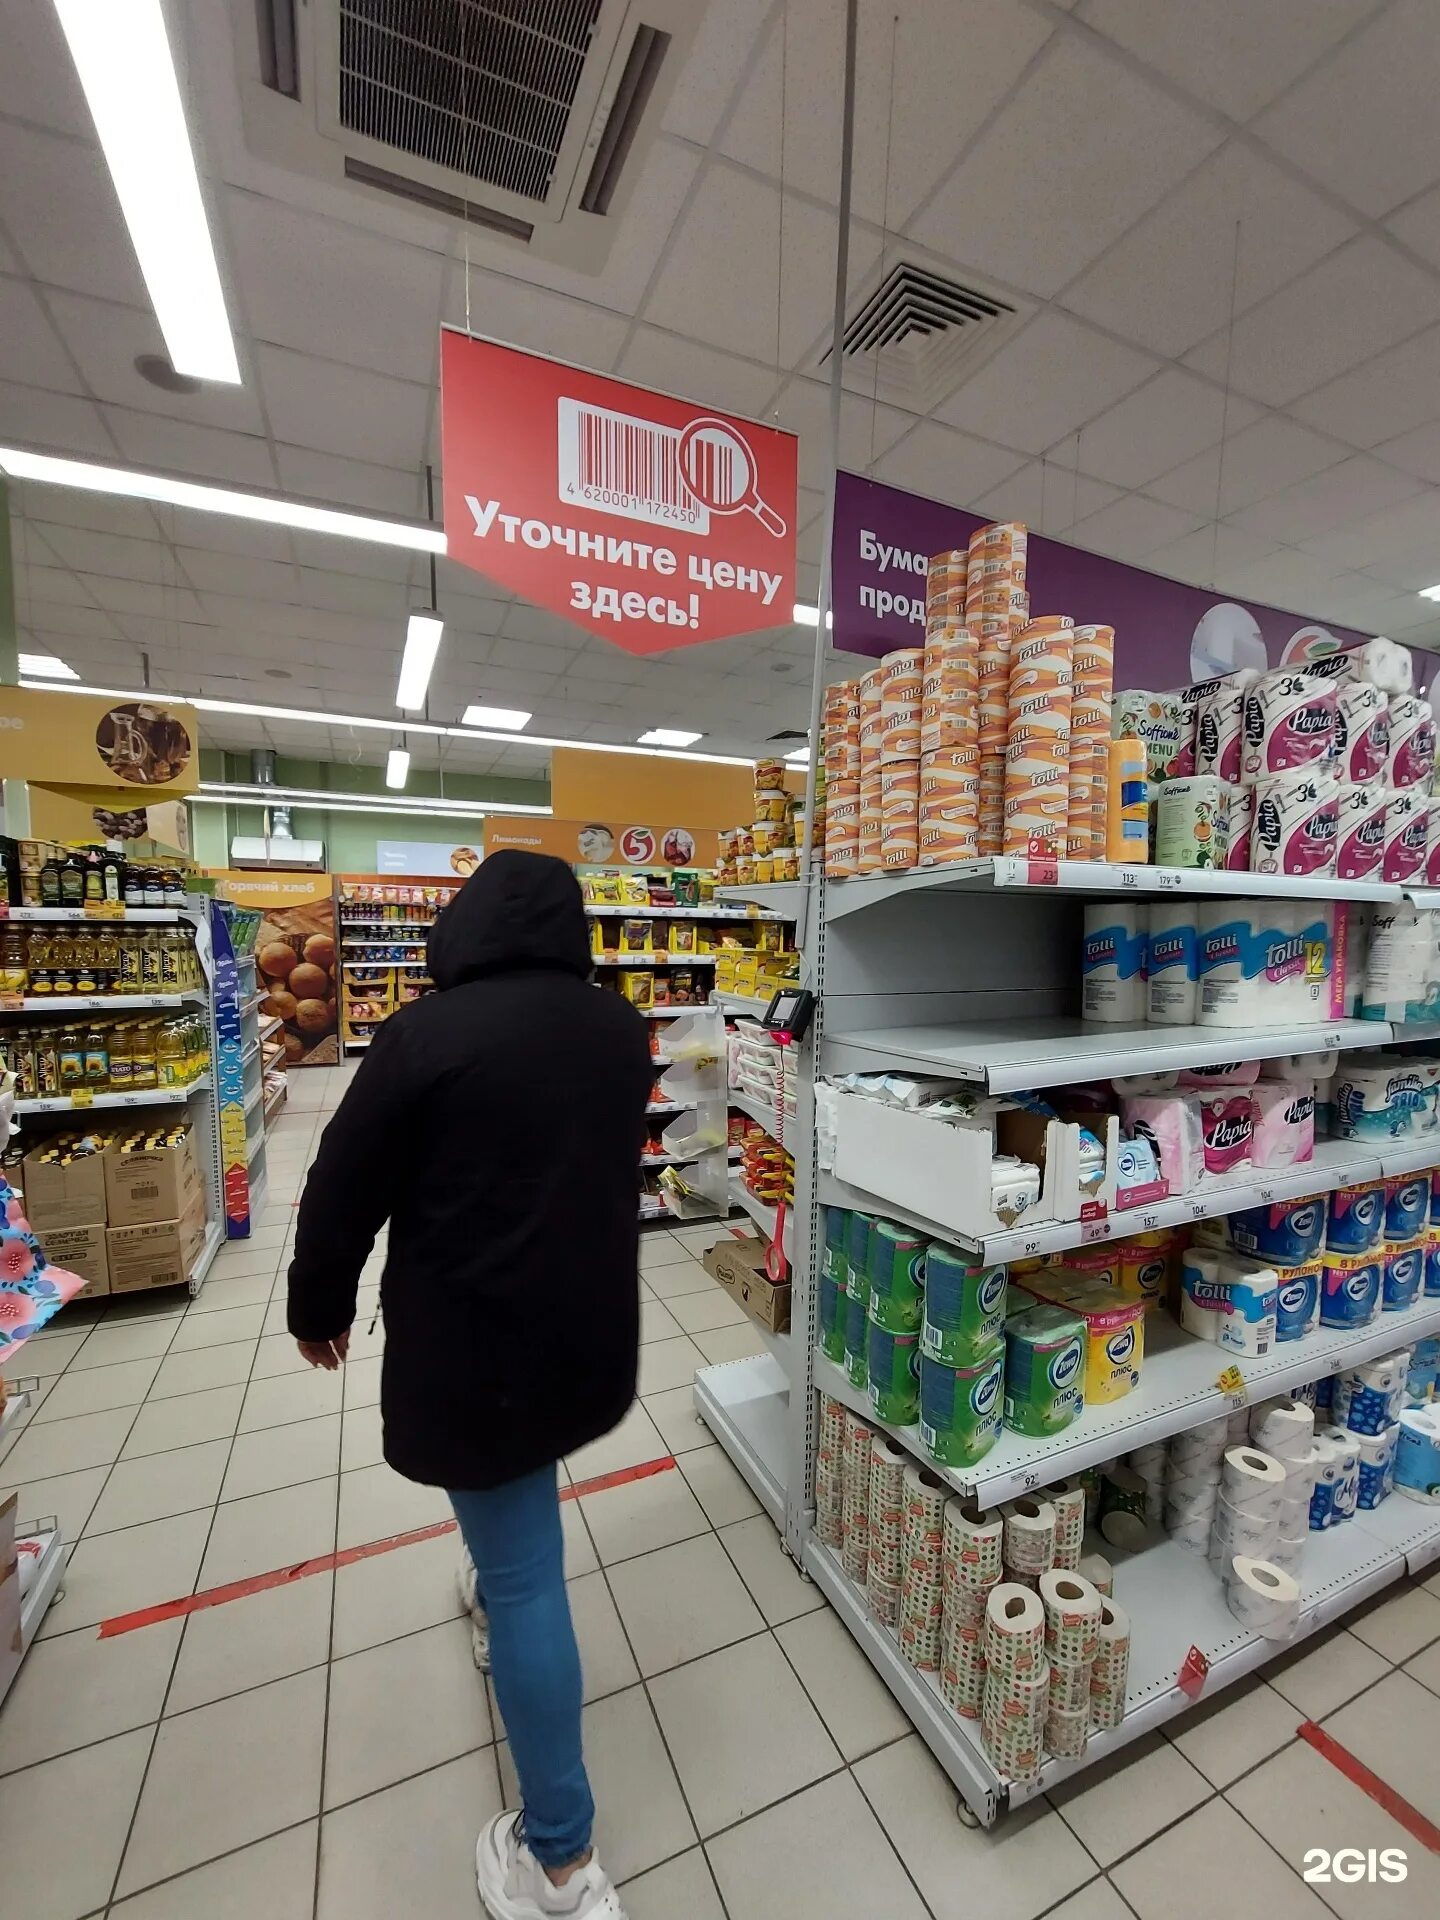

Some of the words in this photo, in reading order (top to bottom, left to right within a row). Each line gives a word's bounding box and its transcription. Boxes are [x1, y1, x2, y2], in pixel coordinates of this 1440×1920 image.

[584, 486, 638, 511] 620001
[647, 500, 696, 524] 172450
[464, 494, 678, 575] Уточните
[688, 554, 783, 605] цену
[570, 581, 699, 629] здесь!
[1293, 708, 1335, 734] Papia
[492, 834, 542, 845] Лимонады
[1087, 938, 1114, 954] tolli
[1155, 938, 1184, 955] tolli
[1206, 934, 1237, 953] tolli
[1265, 935, 1304, 967] tolli
[1335, 915, 1346, 977] УПАКОВКА
[1305, 941, 1325, 976] 12
[1335, 979, 1344, 1003] МЕГА
[1212, 1115, 1252, 1148] Papia
[1193, 1280, 1232, 1301] tolli
[1024, 1476, 1036, 1487] 92
